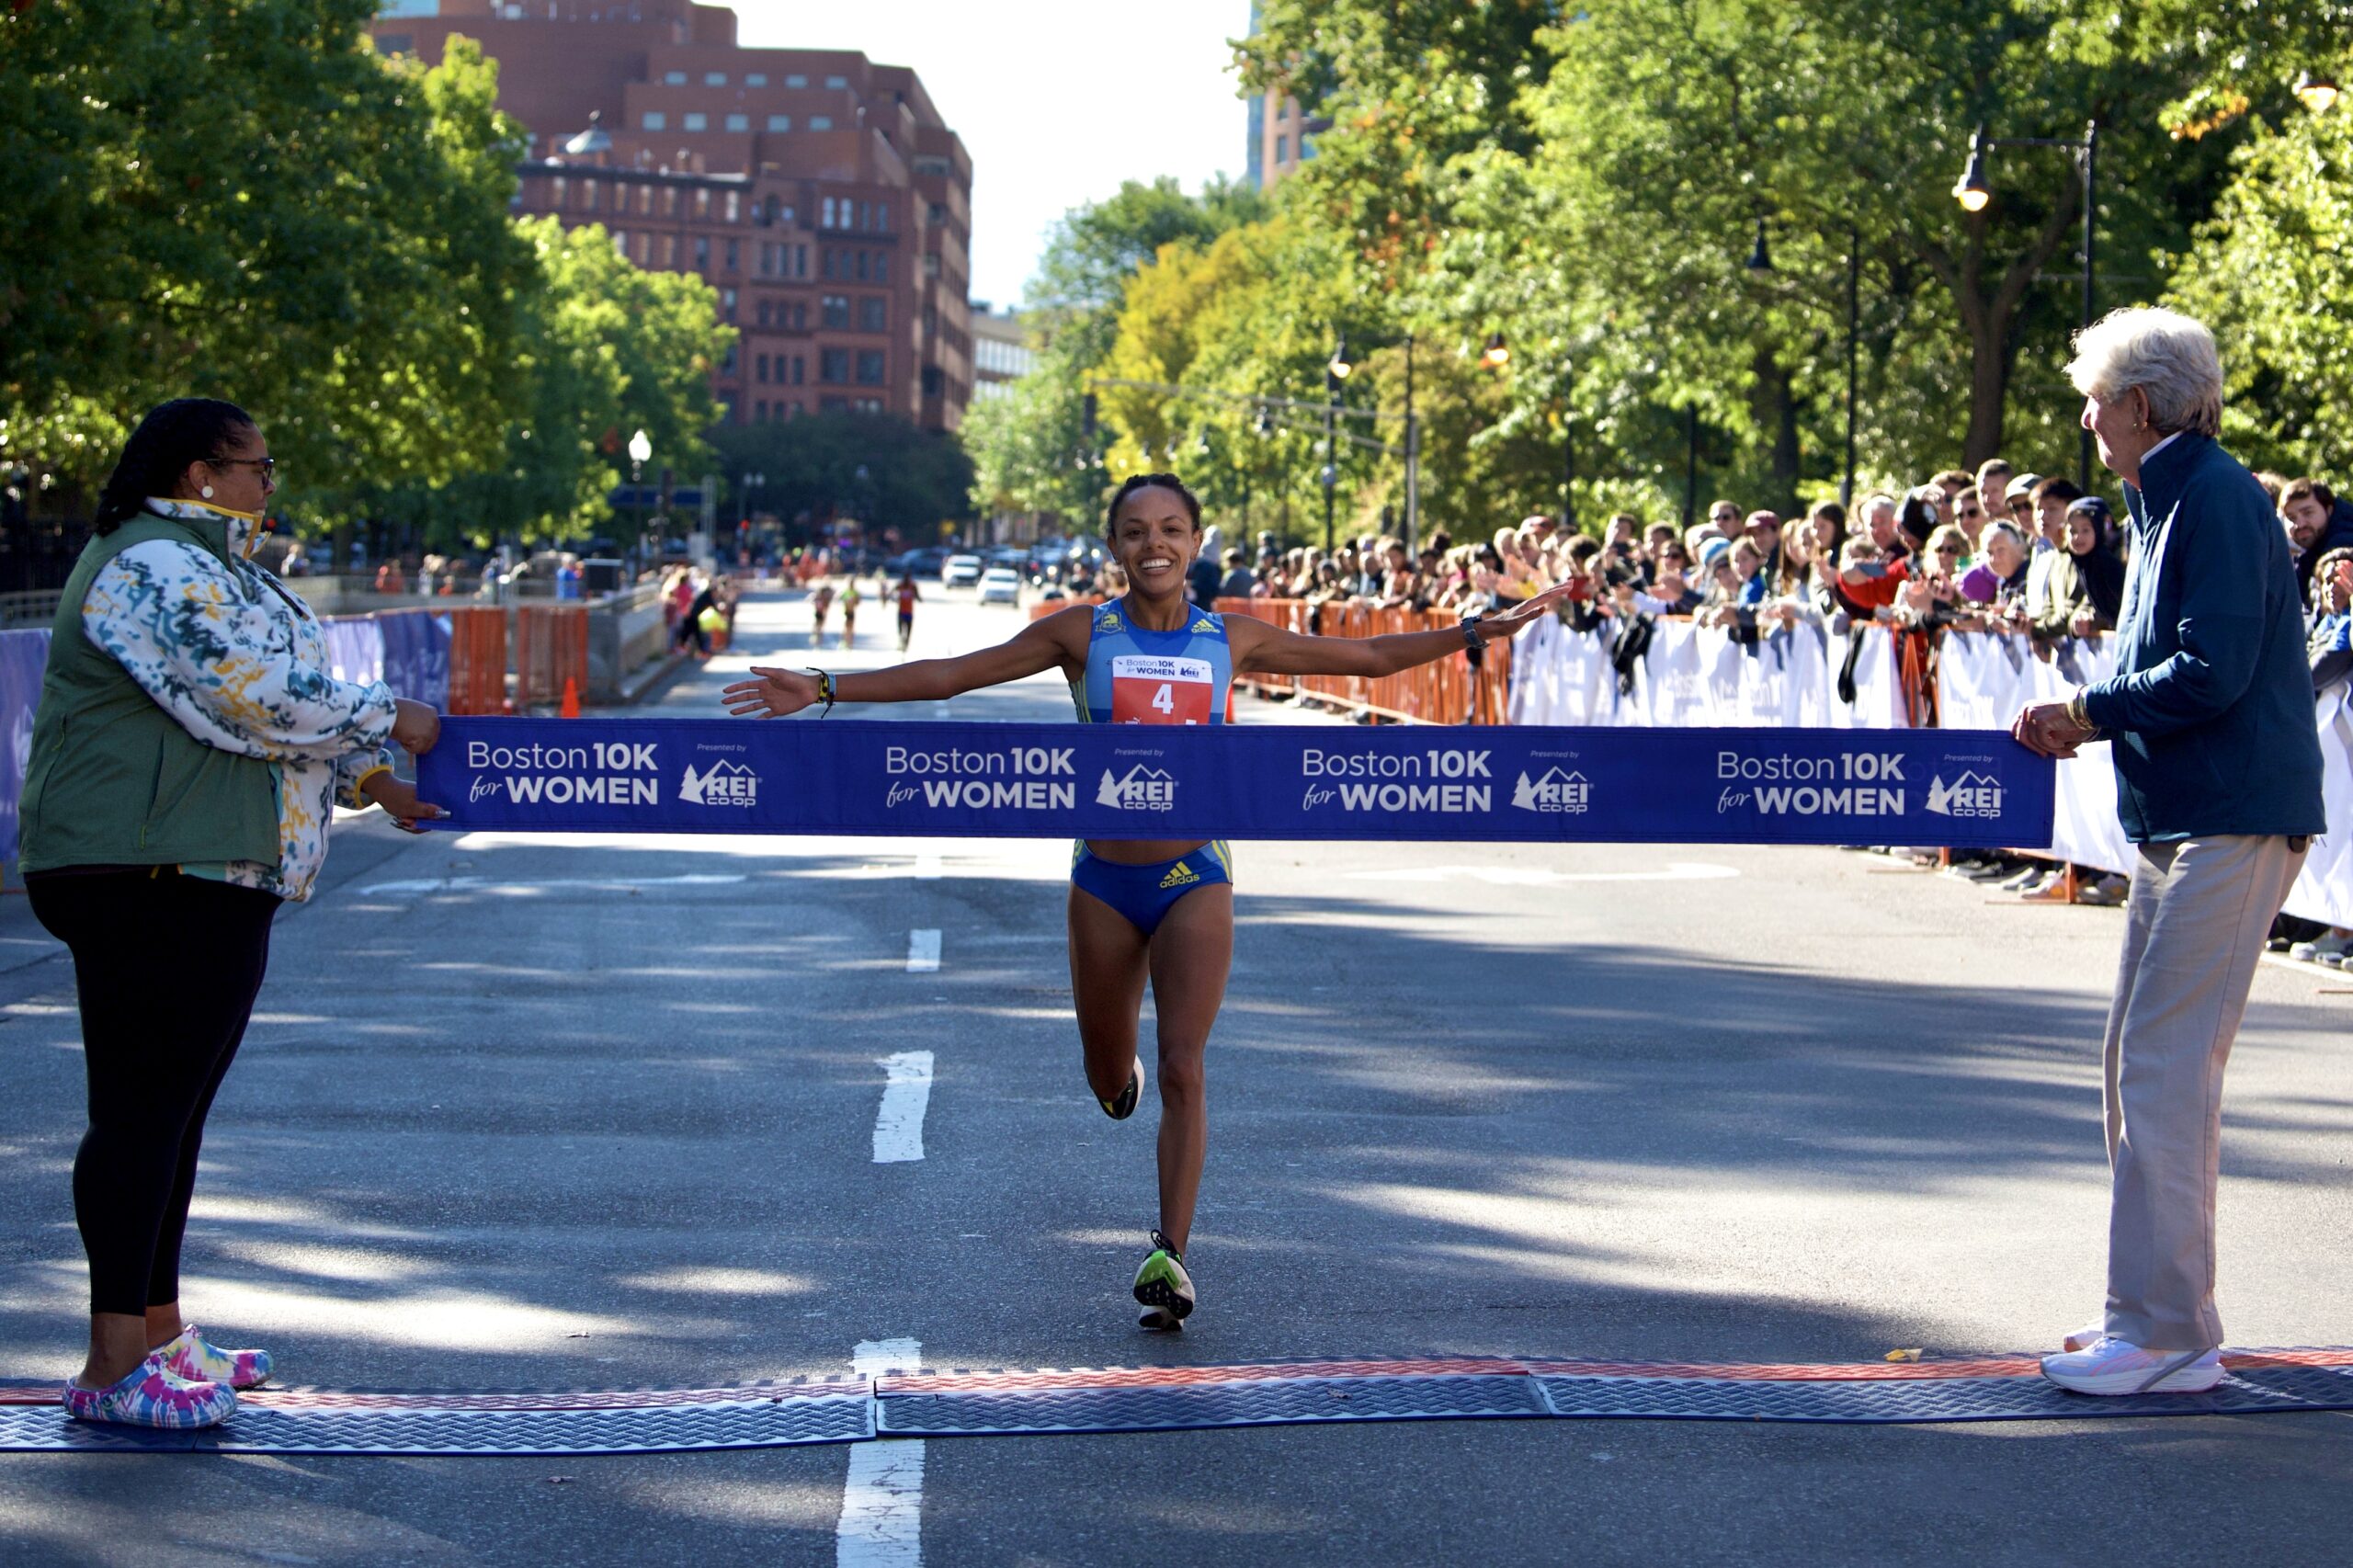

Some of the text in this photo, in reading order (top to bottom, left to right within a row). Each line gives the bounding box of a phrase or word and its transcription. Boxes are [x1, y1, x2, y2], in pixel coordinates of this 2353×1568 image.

[1126, 659, 1157, 667] Boston
[1136, 666, 1176, 676] WOMEN
[1152, 684, 1174, 714] 4
[469, 742, 658, 770] Boston 10K
[887, 747, 1075, 775] Boston 10K
[1303, 749, 1492, 778] Boston 10K
[1718, 752, 1834, 779] Boston
[1841, 753, 1905, 780] 10K
[1944, 754, 1984, 762] Presented
[470, 776, 657, 804] for WOMEN
[887, 781, 1074, 809] for WOMEN
[1303, 783, 1491, 812] for WOMEN
[1718, 787, 1904, 815] for WOMEN
[1159, 873, 1200, 889] adidas
